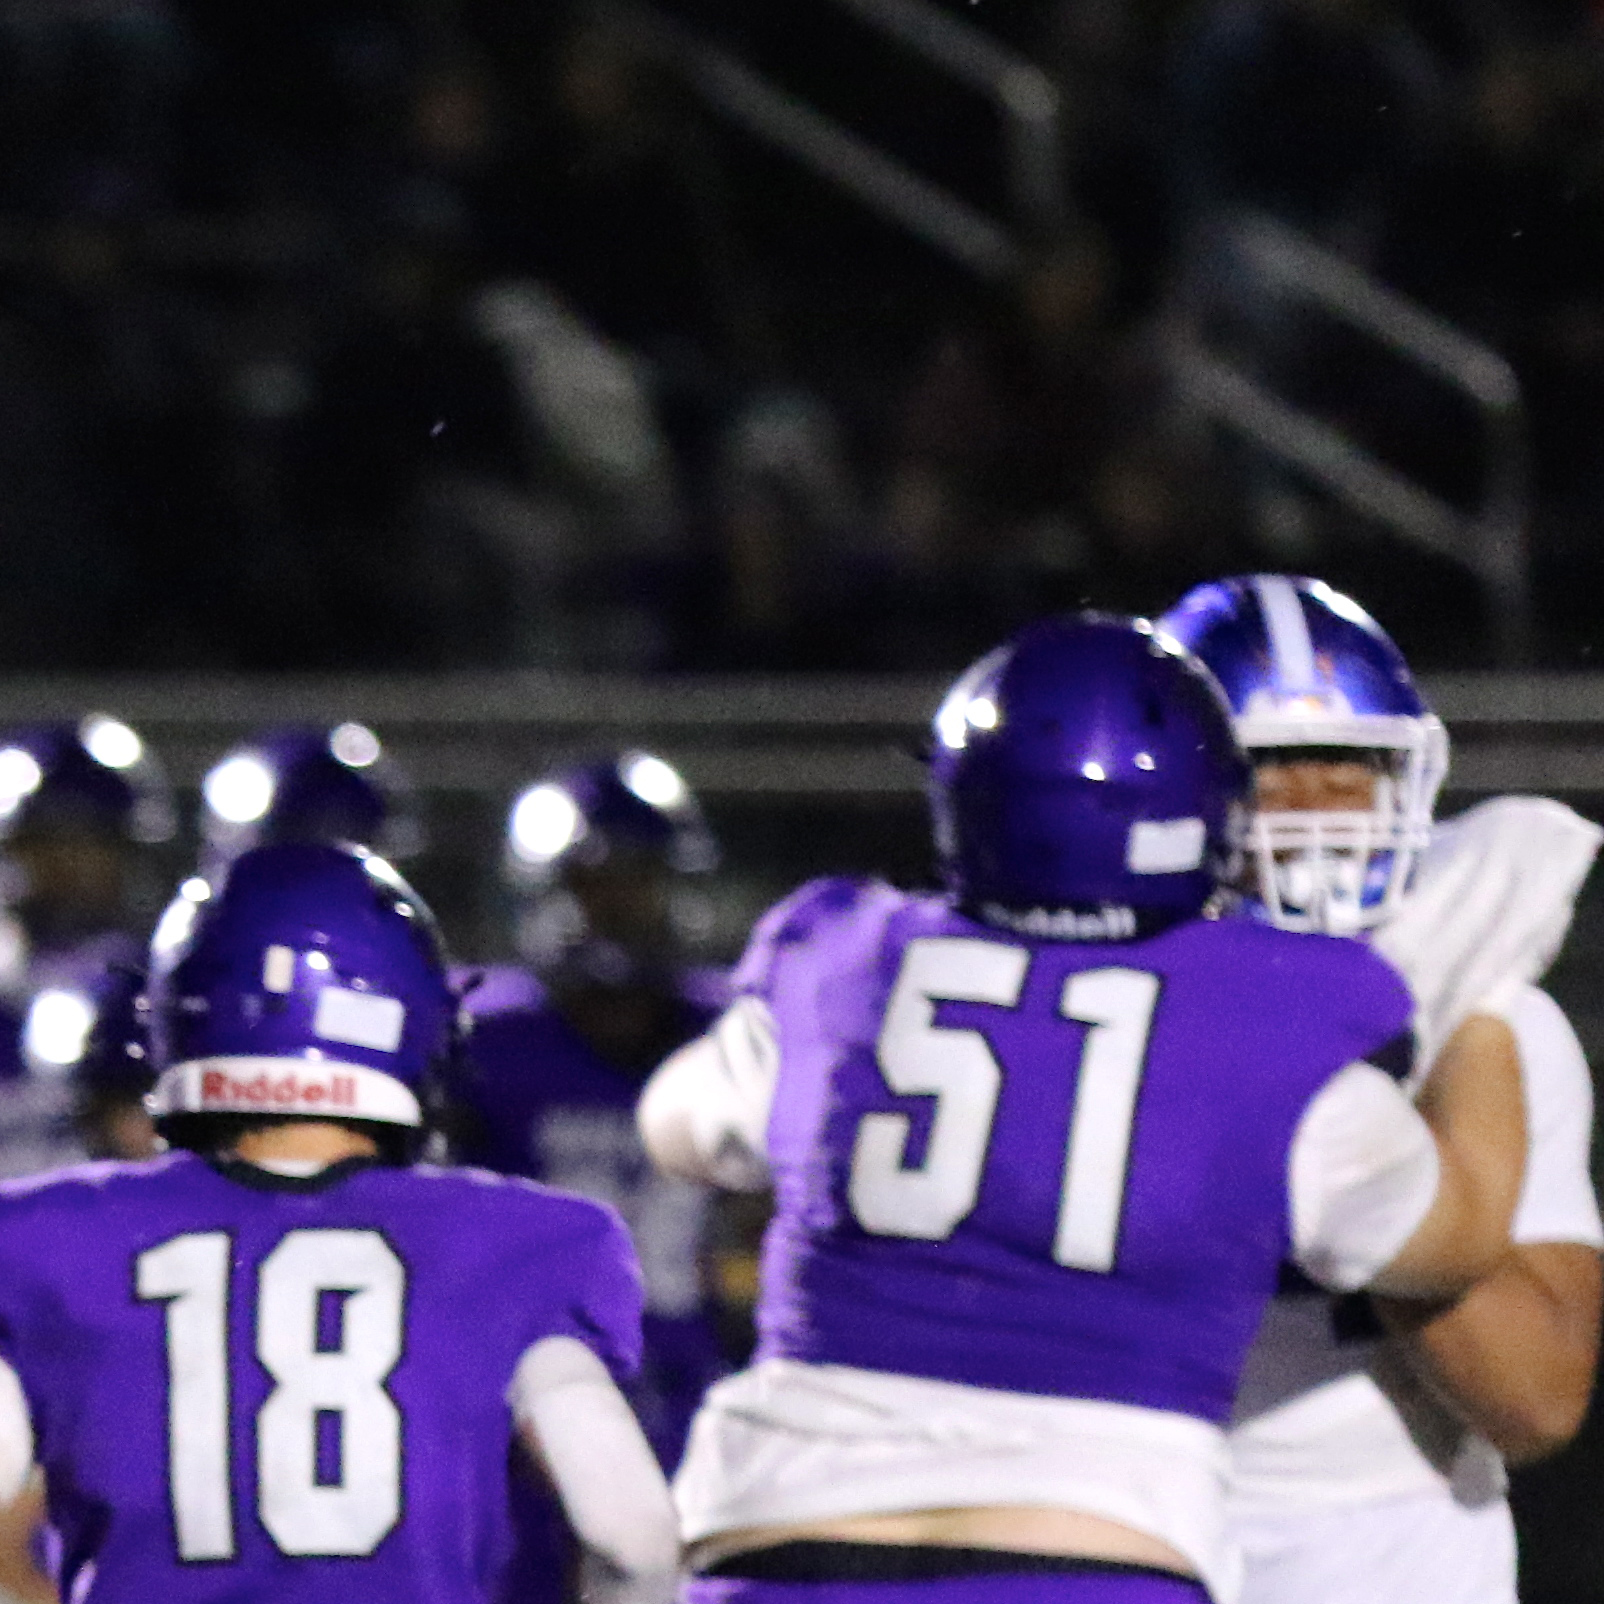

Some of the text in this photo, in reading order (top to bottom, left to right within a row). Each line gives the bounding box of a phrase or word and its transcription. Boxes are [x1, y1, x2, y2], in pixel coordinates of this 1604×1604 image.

[201, 1070, 359, 1108] Riddell
[844, 937, 1160, 1272] 51
[134, 1228, 406, 1563] 18
